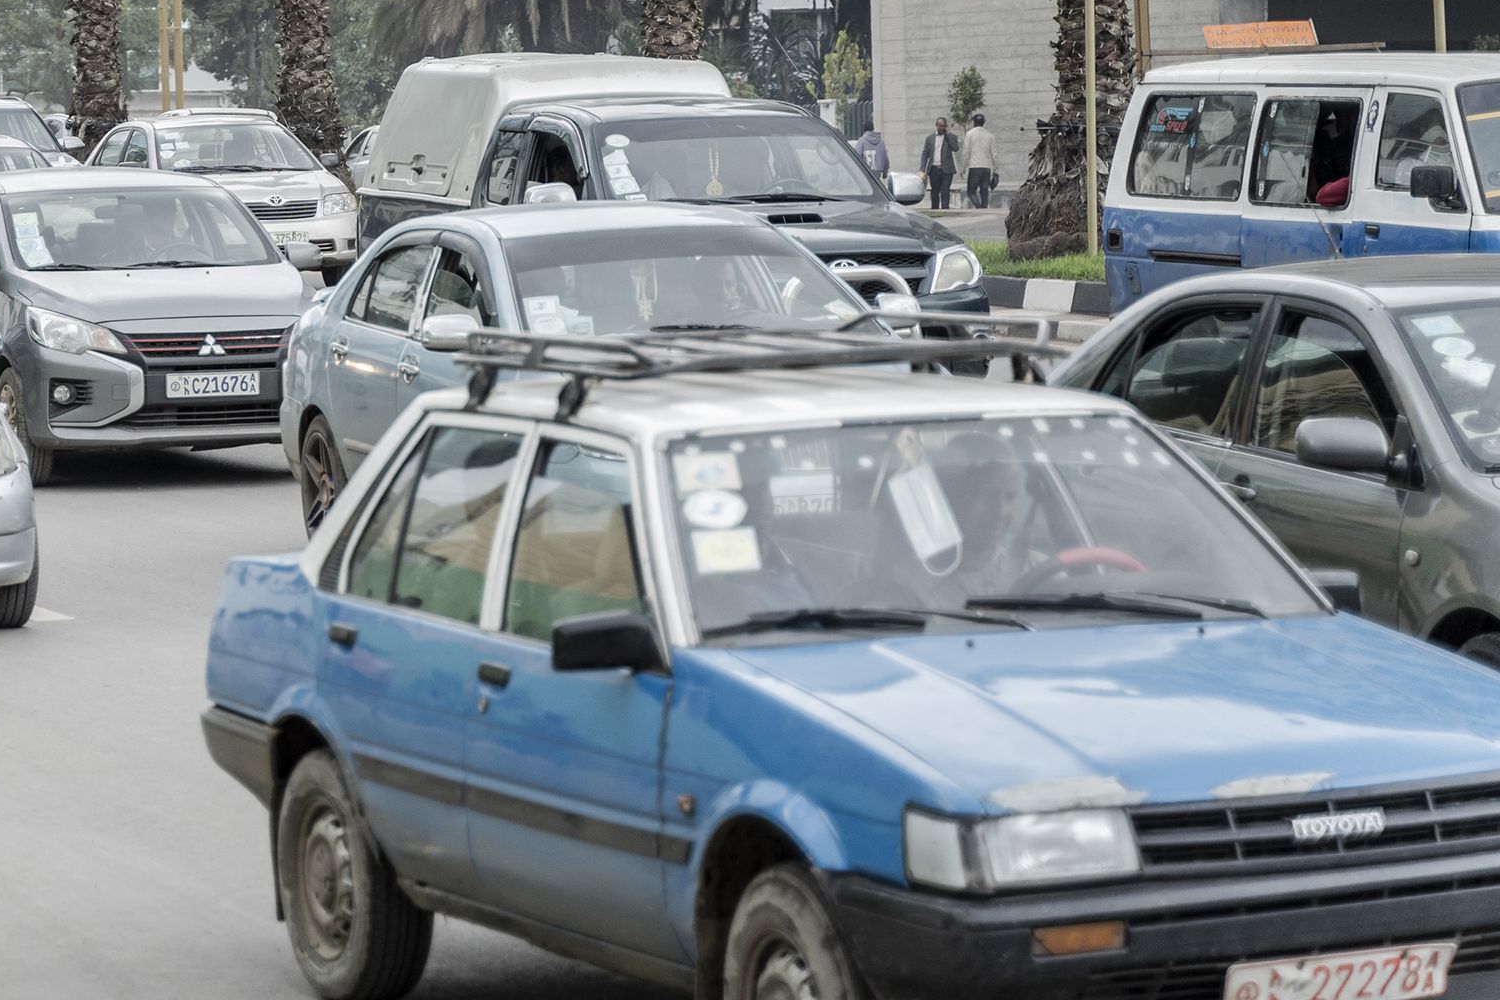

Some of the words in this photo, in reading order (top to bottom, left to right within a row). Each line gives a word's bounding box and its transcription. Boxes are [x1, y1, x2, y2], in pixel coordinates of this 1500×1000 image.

[192, 376, 248, 394] C21676
[1295, 811, 1384, 838] TOYOTA
[1311, 954, 1422, 1000] 27278
